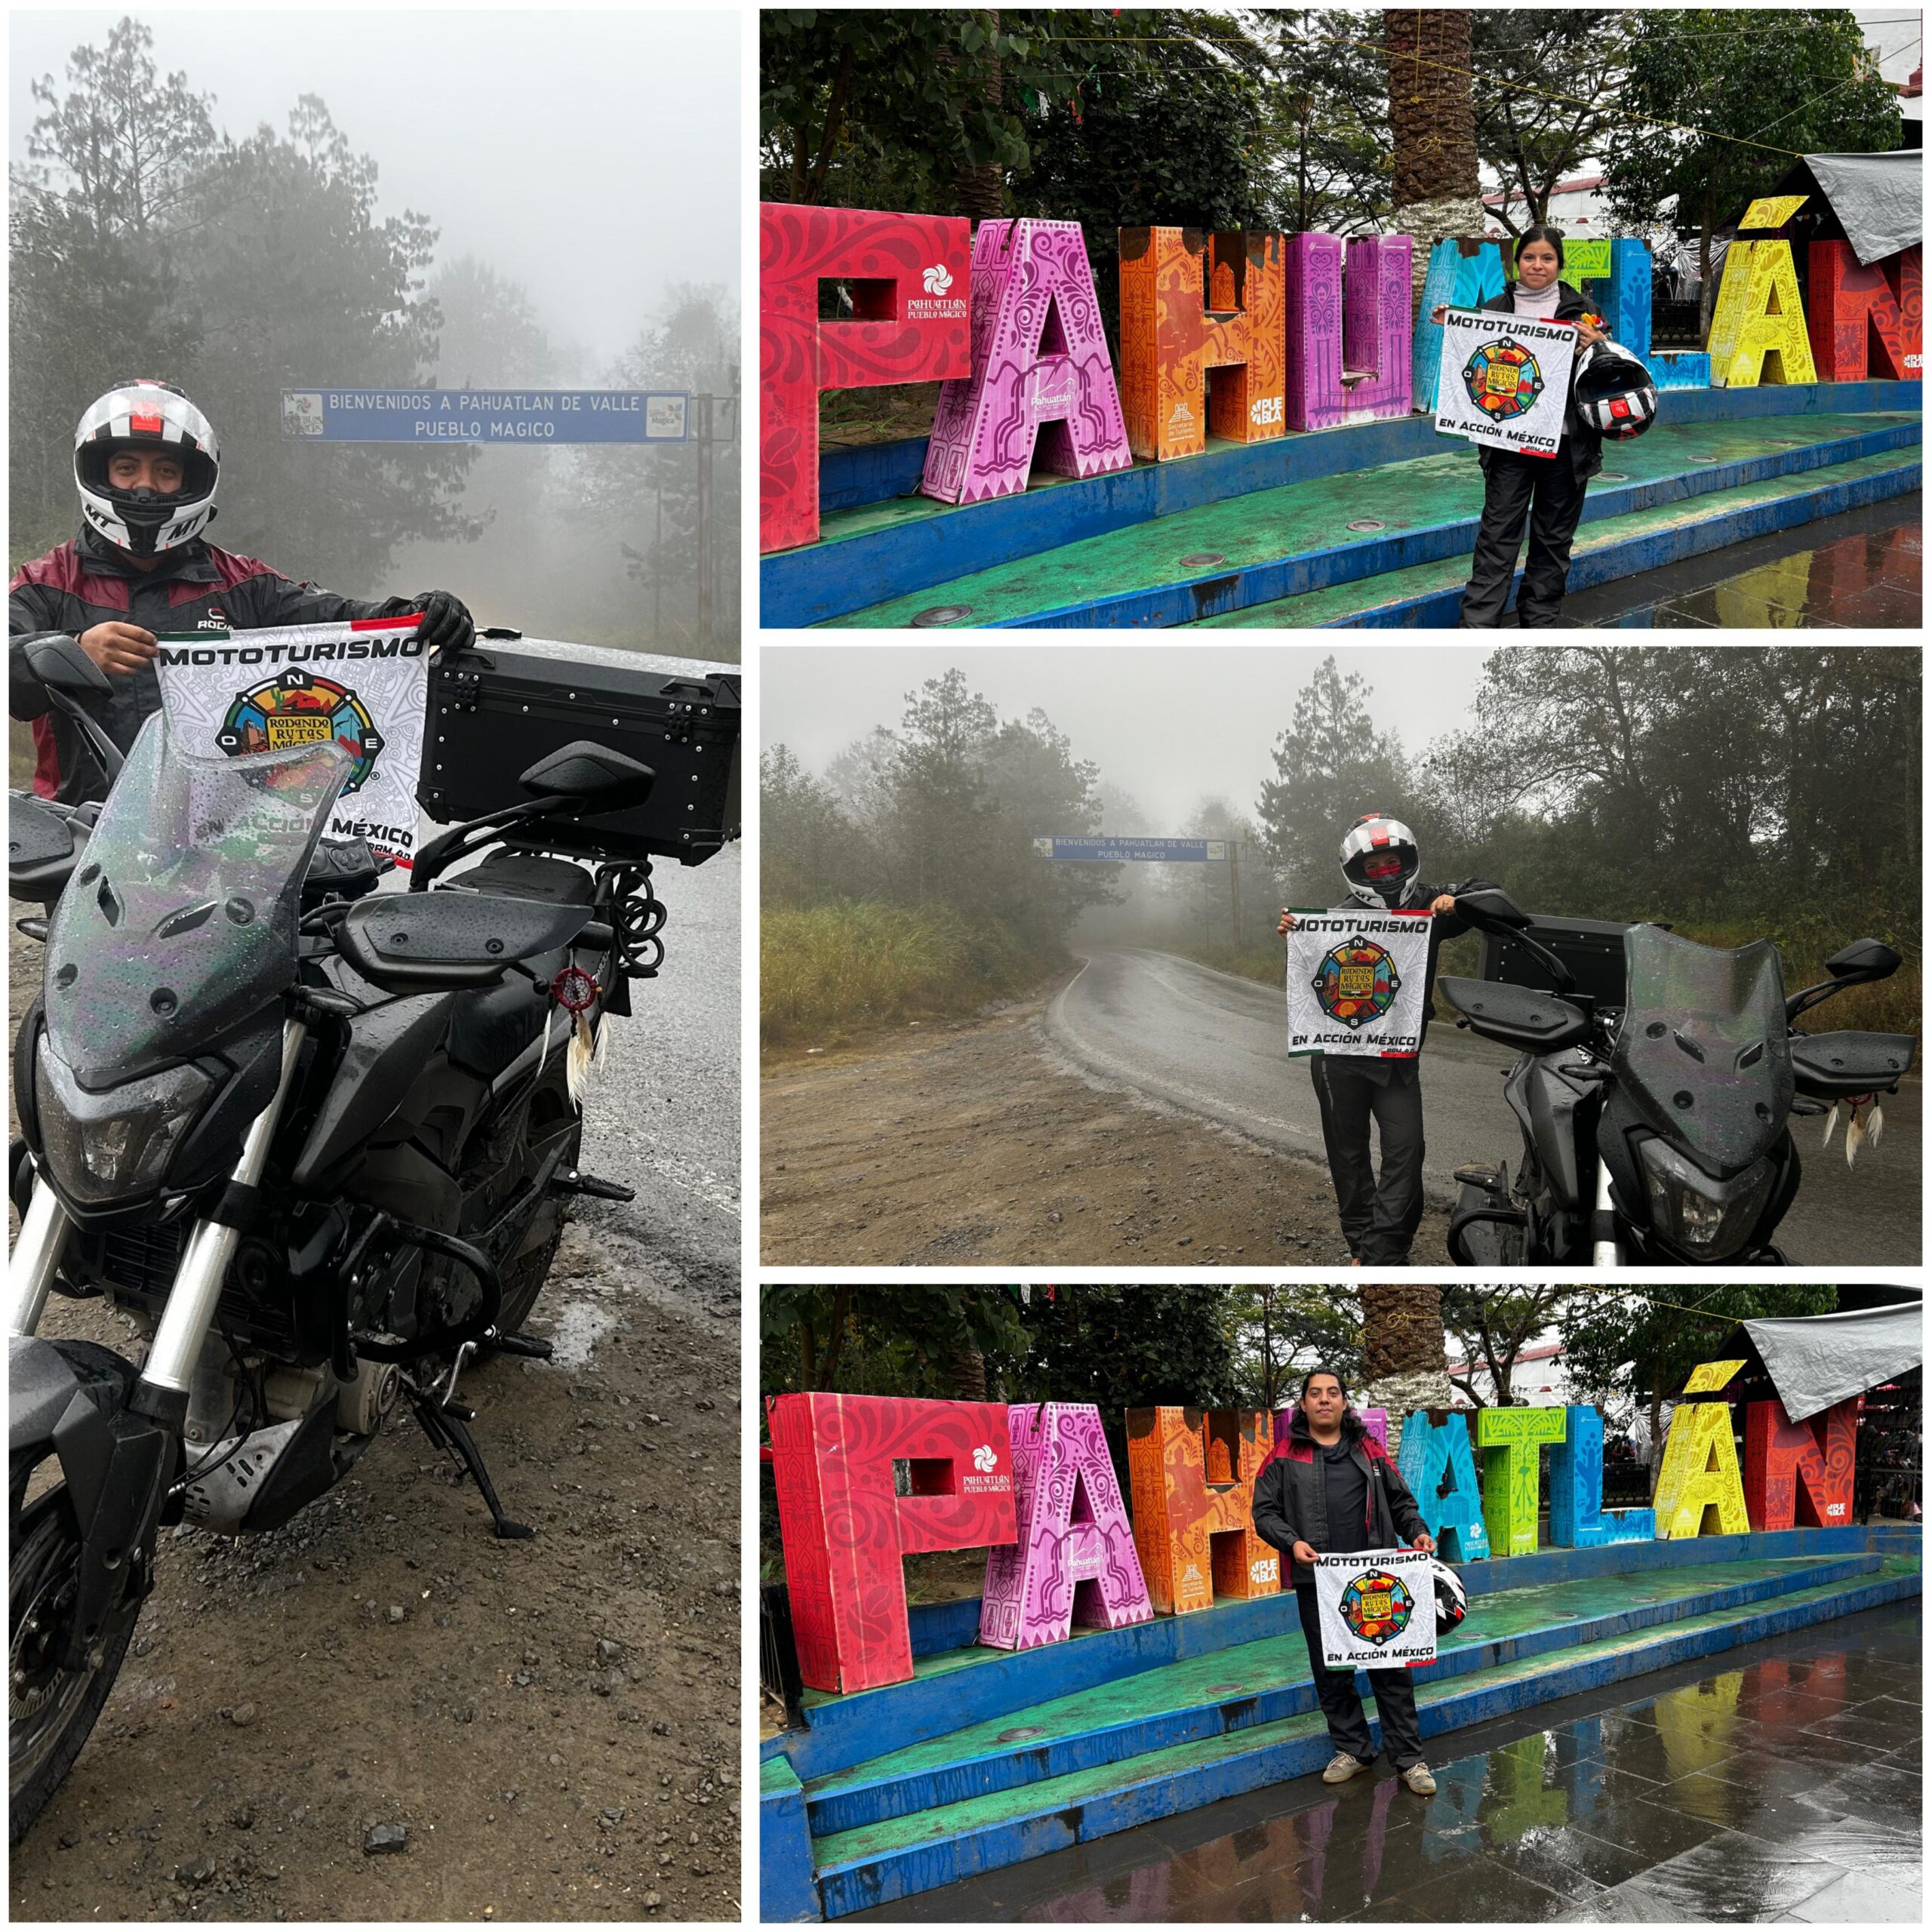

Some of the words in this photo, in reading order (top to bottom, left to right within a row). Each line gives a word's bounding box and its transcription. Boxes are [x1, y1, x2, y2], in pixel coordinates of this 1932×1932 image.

[908, 311, 937, 319] PUEBLO
[1447, 314, 1574, 342] MOTOTURISMO
[1489, 365, 1518, 374] RODANDO
[1491, 371, 1515, 381] RUTAS
[329, 394, 430, 411] BIENVENIDOS
[441, 395, 452, 411] A
[459, 395, 553, 412] PAHUATLAN
[561, 396, 581, 412] DE
[590, 396, 640, 413] VALLE
[1261, 396, 1283, 411] PUE
[1261, 408, 1282, 424] BLA
[415, 422, 481, 438] PUEBLO
[491, 422, 555, 438] MAGICO
[1439, 418, 1456, 428] EN
[1460, 421, 1503, 438] ACCIÓN
[1506, 429, 1555, 448] MÉXICO
[85, 503, 112, 528] MT
[168, 515, 202, 540] MT
[160, 637, 424, 666] MOTOTURISMO
[287, 674, 304, 685] N
[269, 718, 329, 728] RODANDO
[221, 735, 237, 746] O
[276, 729, 325, 740] RUTAS
[365, 738, 377, 749] E
[332, 818, 413, 848] MÉXICO
[1055, 838, 1106, 846] BIENVENIDOS
[1119, 839, 1164, 848] PAHUATLAN
[1355, 891, 1374, 902] MT
[1294, 918, 1429, 934] MOTOTURISMO
[1292, 1034, 1309, 1046] EN
[1313, 1032, 1361, 1044] ACCIÓN
[1367, 1033, 1417, 1046] MÉXICO
[964, 1485, 988, 1494] PUEBLO
[766, 1359, 1858, 1694] PAHATLÁN
[1260, 1558, 1278, 1572] PUE
[1316, 1553, 1429, 1567] MOTOTURISMO
[1260, 1569, 1278, 1583] BLA
[1327, 1654, 1342, 1662] EN
[1346, 1647, 1387, 1661] ACCIÓN
[1392, 1646, 1434, 1658] MÉXICO
